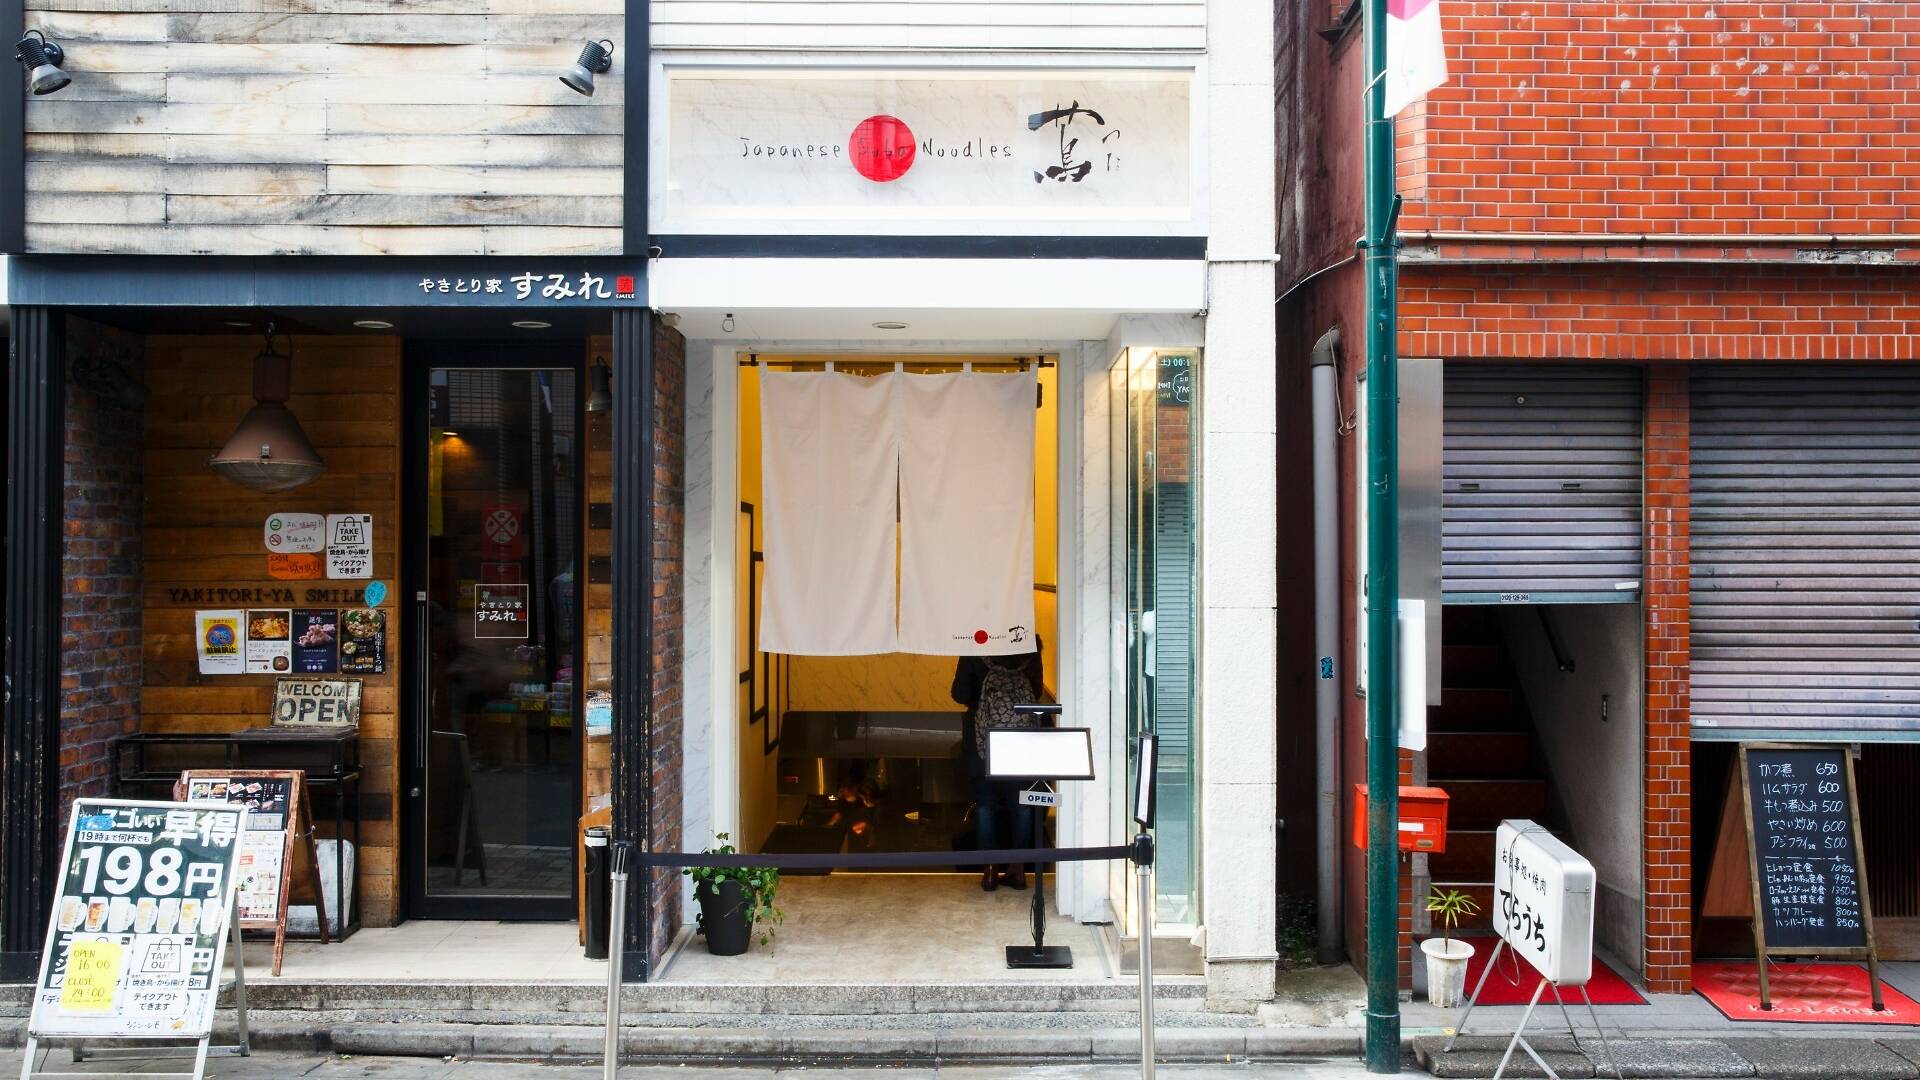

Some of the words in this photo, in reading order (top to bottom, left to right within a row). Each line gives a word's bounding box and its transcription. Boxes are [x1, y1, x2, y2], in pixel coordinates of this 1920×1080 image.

[740, 137, 841, 159] Japanese
[922, 137, 1013, 158] Noodles
[419, 278, 503, 293] やきとり家
[510, 272, 612, 300] すみれ
[168, 588, 294, 601] YAKITORI-YA
[476, 610, 517, 622] すみれ
[277, 698, 353, 722] OPEN
[1758, 763, 1796, 778] かつ煮
[1815, 762, 1838, 776] 650
[1762, 783, 1808, 795] ハムサラダ
[1818, 780, 1840, 794] 600
[1027, 794, 1054, 803] OPEN
[1764, 800, 1817, 814] 牛もつ煮込み
[1821, 800, 1844, 813] 500
[160, 809, 238, 847] 早得
[1767, 817, 1818, 831] やさい炒め
[1822, 819, 1847, 832] 600
[80, 831, 151, 843] 19時まで何杯でも
[1824, 836, 1847, 849] 500
[80, 845, 224, 898] 198円
[1773, 907, 1813, 916] カツカレー
[1499, 888, 1546, 953] てらうち
[73, 949, 96, 958] OPEN
[151, 952, 177, 960] TAKE
[151, 961, 172, 969] OU
[133, 993, 179, 1001] テイクアウト
[139, 1003, 171, 1011] できます
